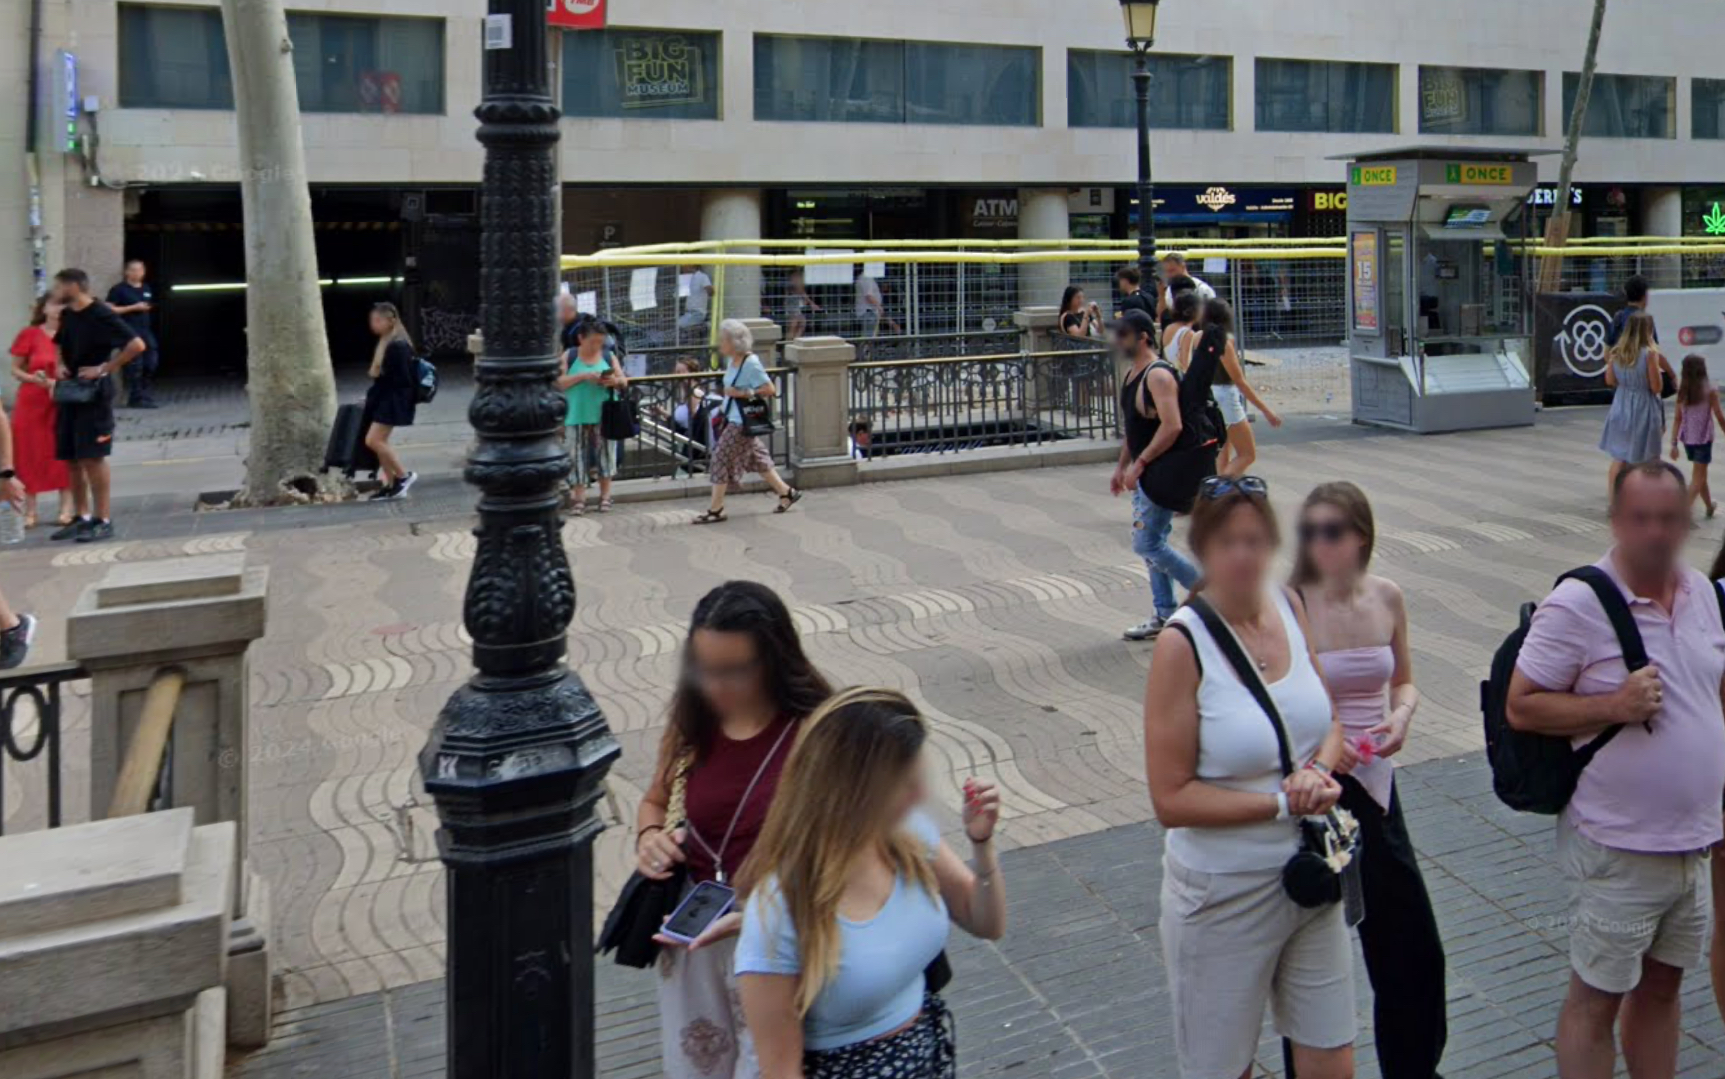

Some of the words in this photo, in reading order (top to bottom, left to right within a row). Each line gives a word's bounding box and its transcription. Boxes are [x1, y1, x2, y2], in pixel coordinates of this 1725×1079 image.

[624, 37, 688, 60] BIG
[626, 61, 689, 84] FUN
[626, 82, 690, 96] MUSEUM
[1364, 167, 1394, 184] ONCE
[1466, 167, 1507, 181] ONCE
[1196, 187, 1236, 205] valdés
[973, 199, 1018, 216] ATM
[603, 226, 615, 240] P
[1356, 261, 1371, 280] 15
